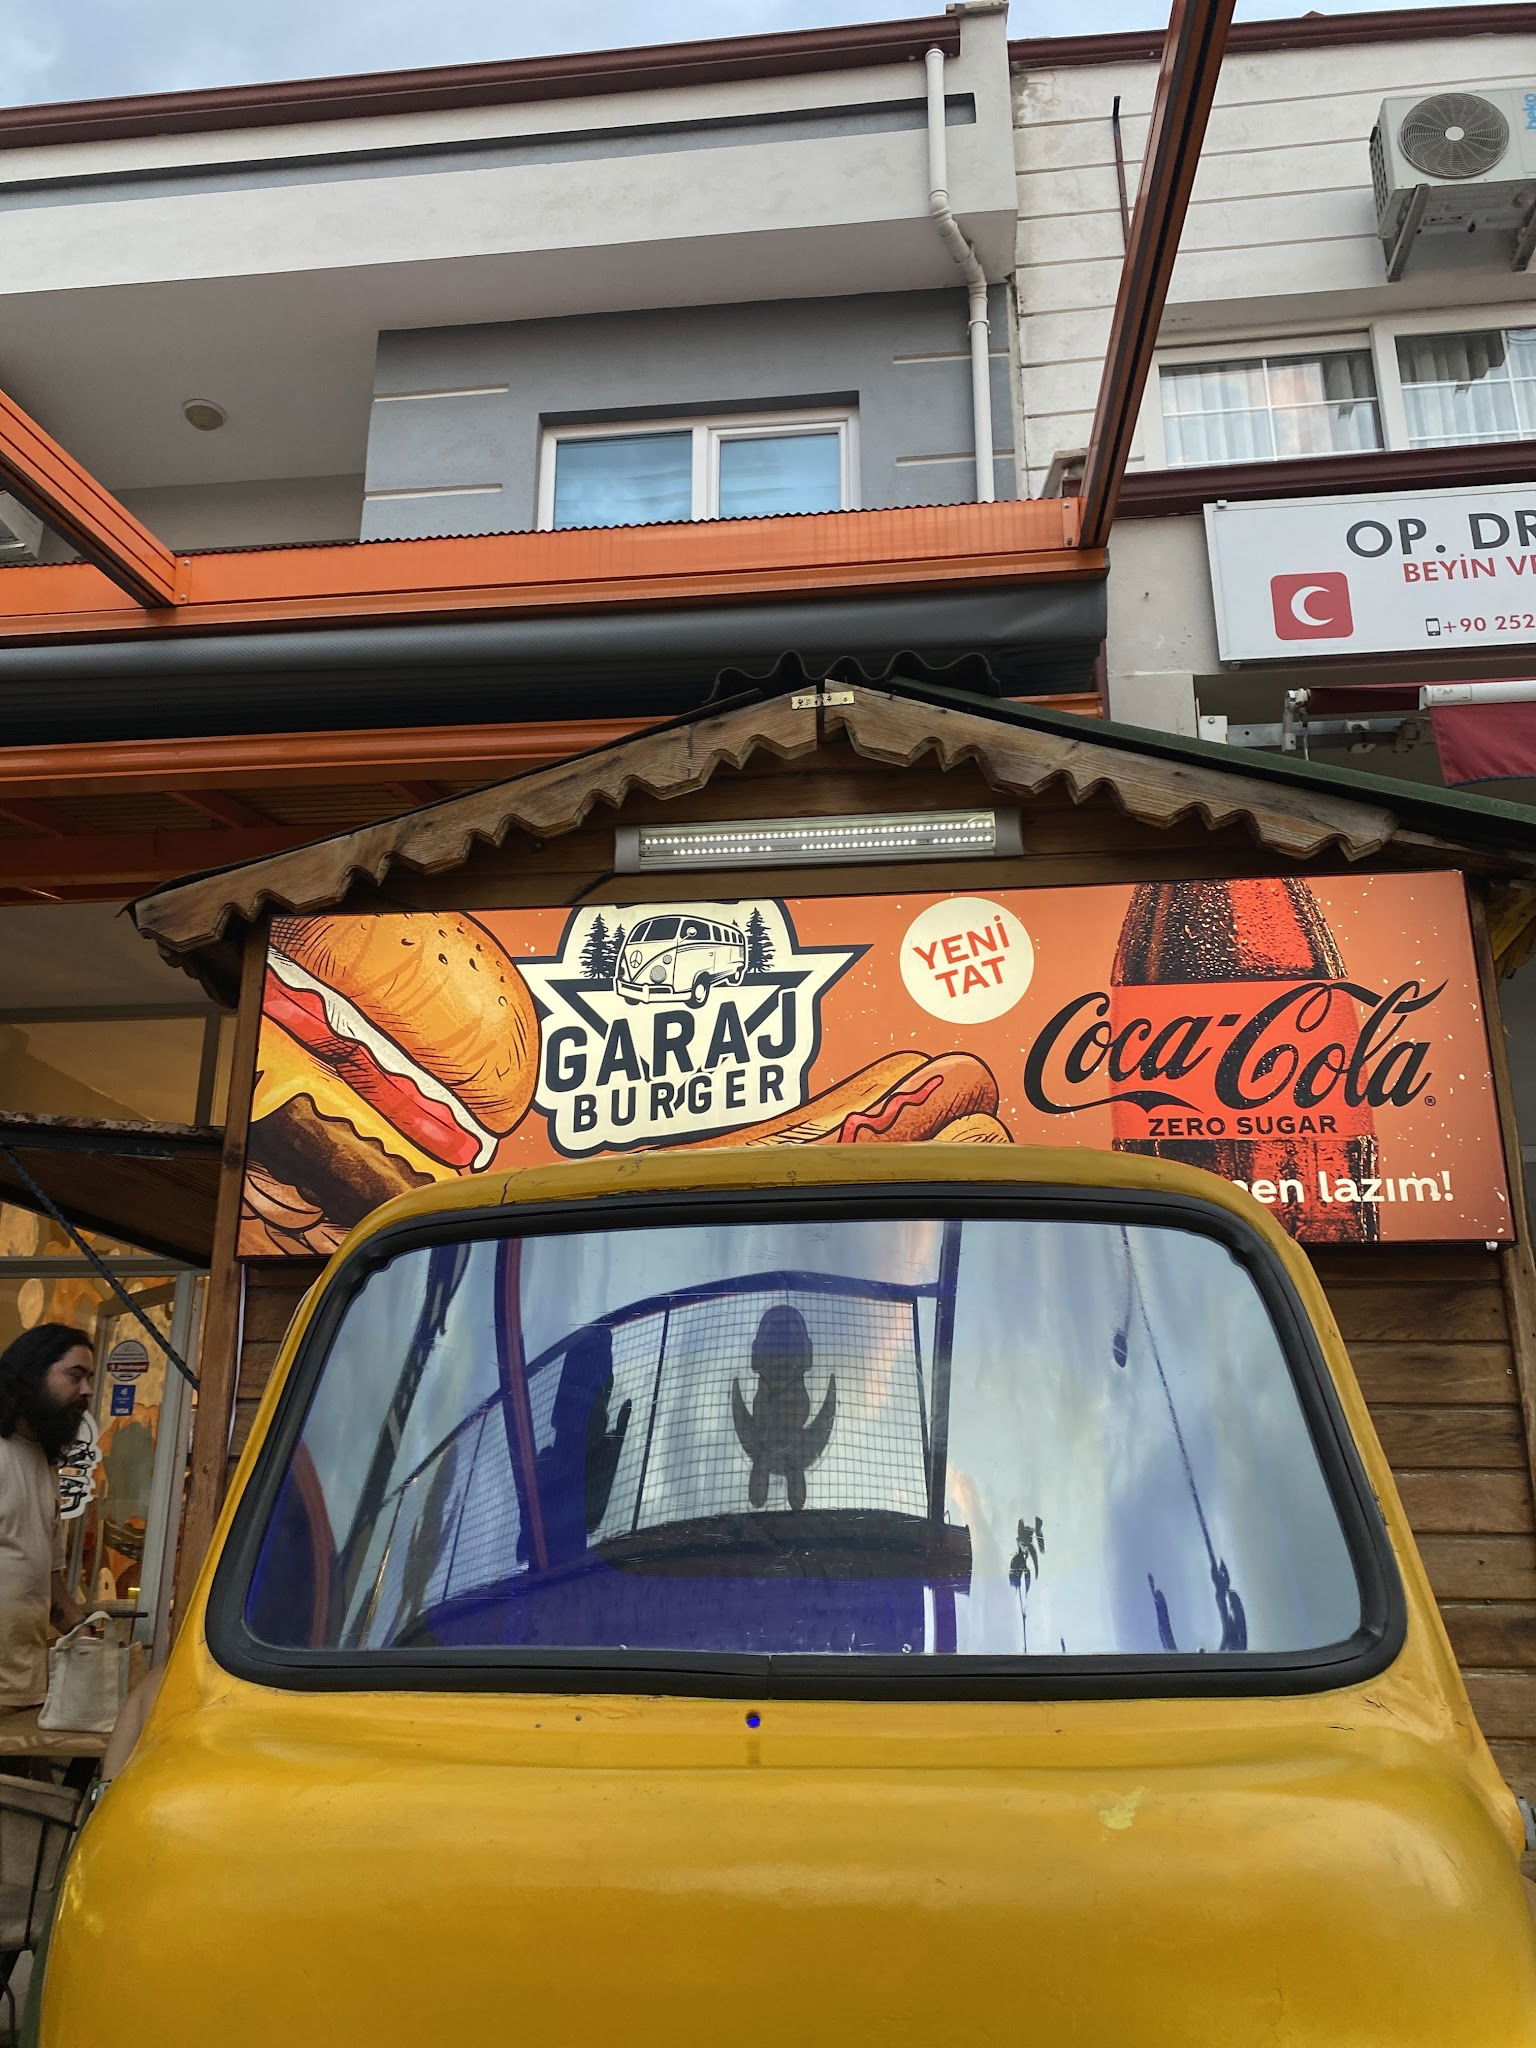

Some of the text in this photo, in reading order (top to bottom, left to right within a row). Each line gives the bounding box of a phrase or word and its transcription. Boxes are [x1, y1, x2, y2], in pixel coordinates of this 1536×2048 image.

[1346, 519, 1446, 558] OP.
[1403, 553, 1496, 583] BEYİN
[1443, 613, 1536, 633] +90 252
[913, 914, 1012, 970] YENİ
[935, 956, 1006, 999] TAT
[545, 990, 797, 1093] GARAJ
[1023, 978, 1450, 1115] Coca-Cola
[573, 1064, 785, 1133] BURGER
[1148, 1114, 1338, 1137] ZERO SUGAR
[1318, 1170, 1455, 1204] lazım!
